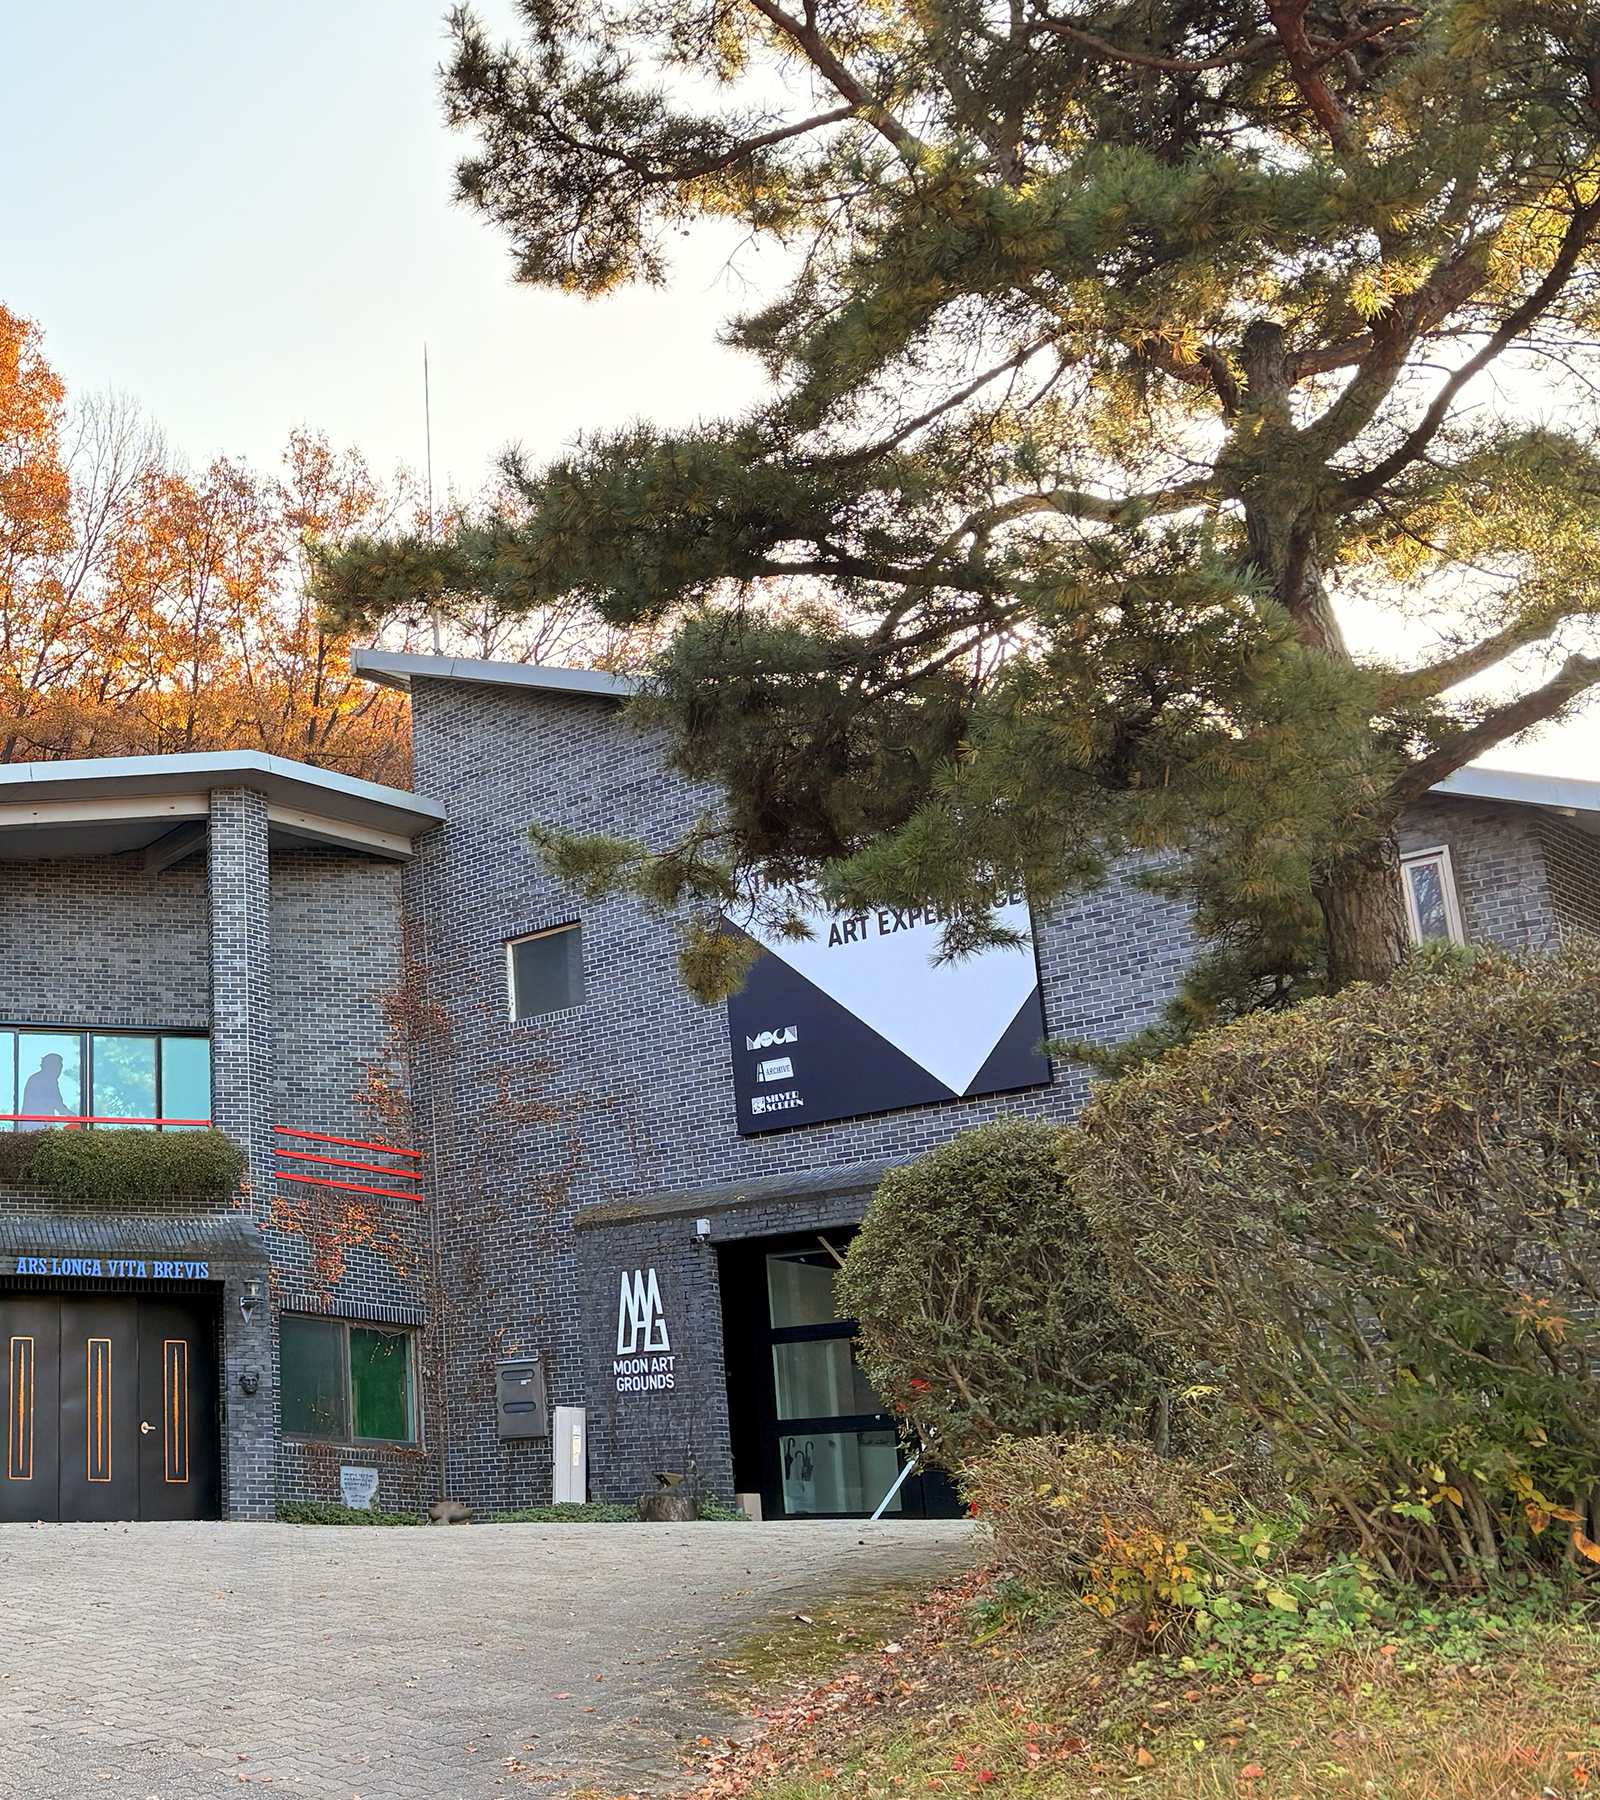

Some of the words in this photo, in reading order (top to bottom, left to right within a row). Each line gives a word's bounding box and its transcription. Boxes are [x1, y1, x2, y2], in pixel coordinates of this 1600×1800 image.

[828, 914, 869, 948] ART
[878, 890, 1023, 936] EXPERICE
[766, 1064, 791, 1076] ARCHIVE
[766, 1090, 799, 1103] SILVER
[766, 1098, 804, 1112] SCREEN
[16, 1256, 47, 1275] ARS
[51, 1258, 101, 1277] LONGA
[106, 1260, 147, 1278] VITA
[152, 1261, 210, 1279] BREVIS
[613, 1357, 649, 1375] MOON
[651, 1356, 676, 1372] ART
[616, 1374, 675, 1392] GROUNDS
